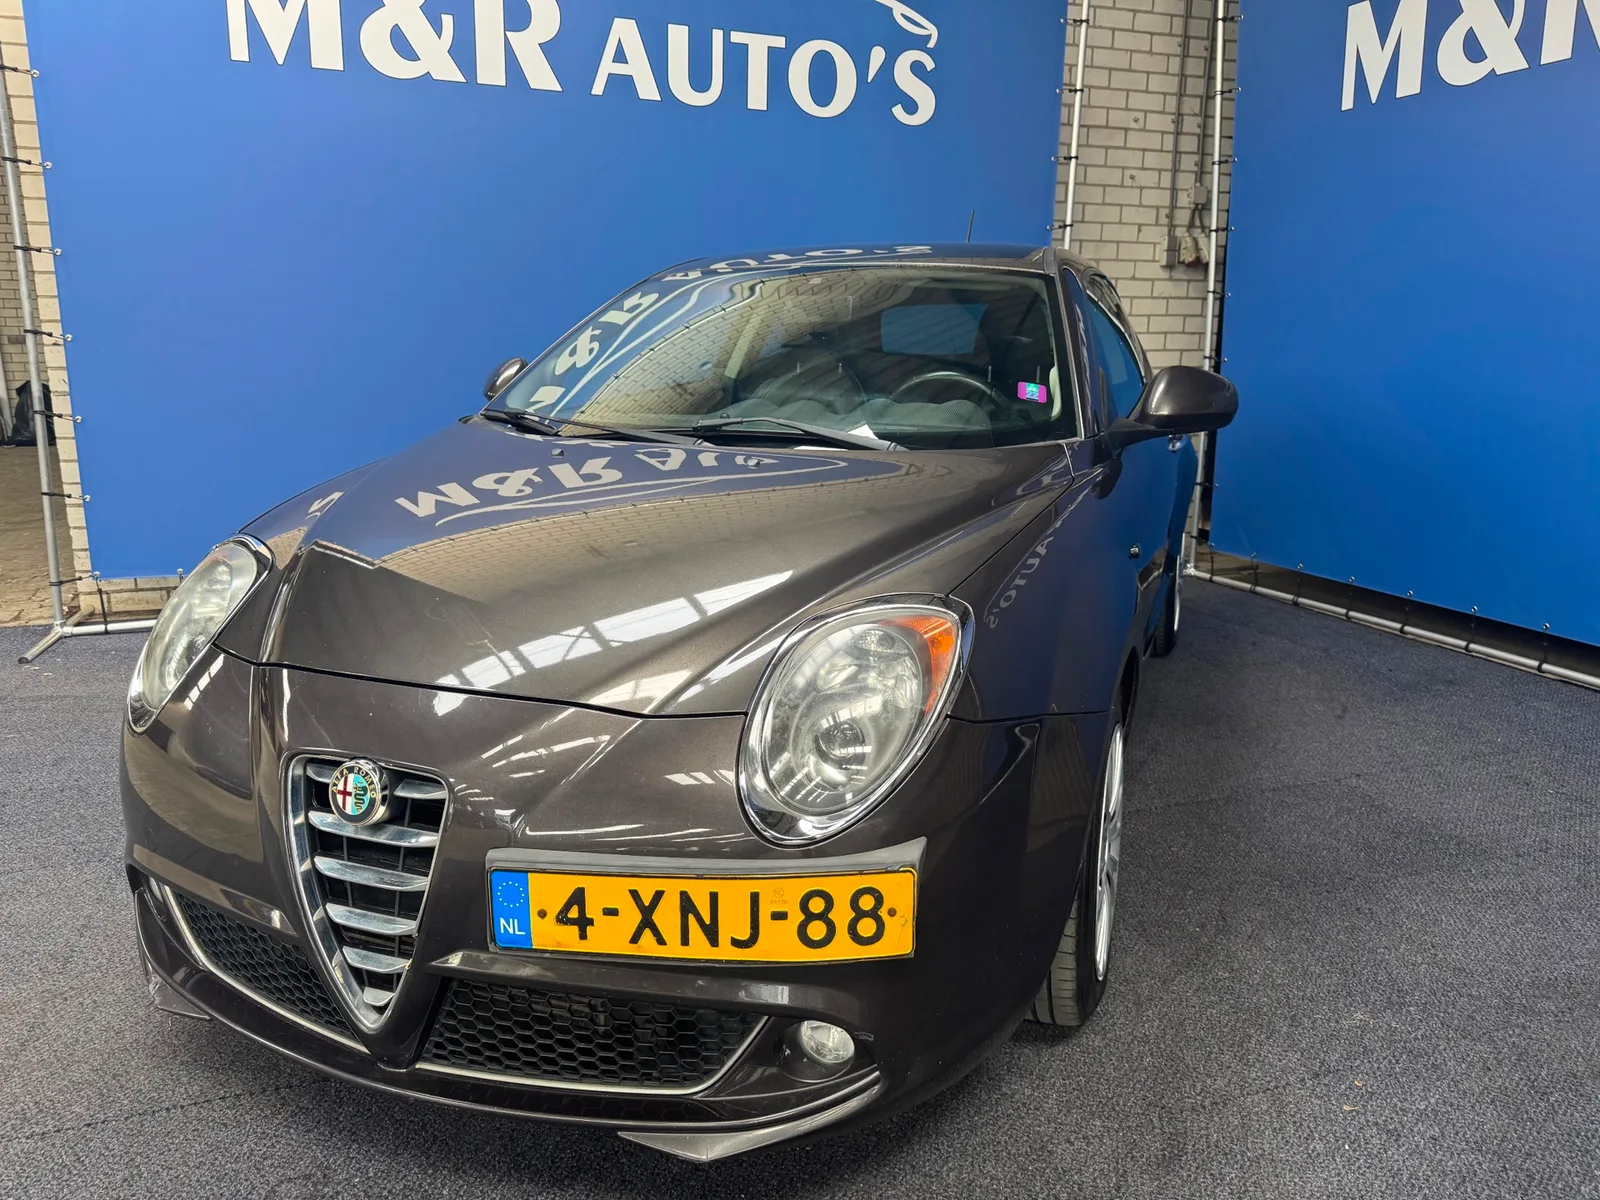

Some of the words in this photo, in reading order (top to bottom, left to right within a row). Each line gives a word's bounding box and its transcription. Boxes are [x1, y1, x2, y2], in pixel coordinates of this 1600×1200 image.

[225, 0, 563, 92] M&R
[591, 17, 937, 126] AUTO'S
[332, 768, 349, 793] ALFA
[353, 766, 377, 798] ROMEO
[500, 917, 526, 935] NL
[554, 886, 886, 950] 4-XNJ-88
